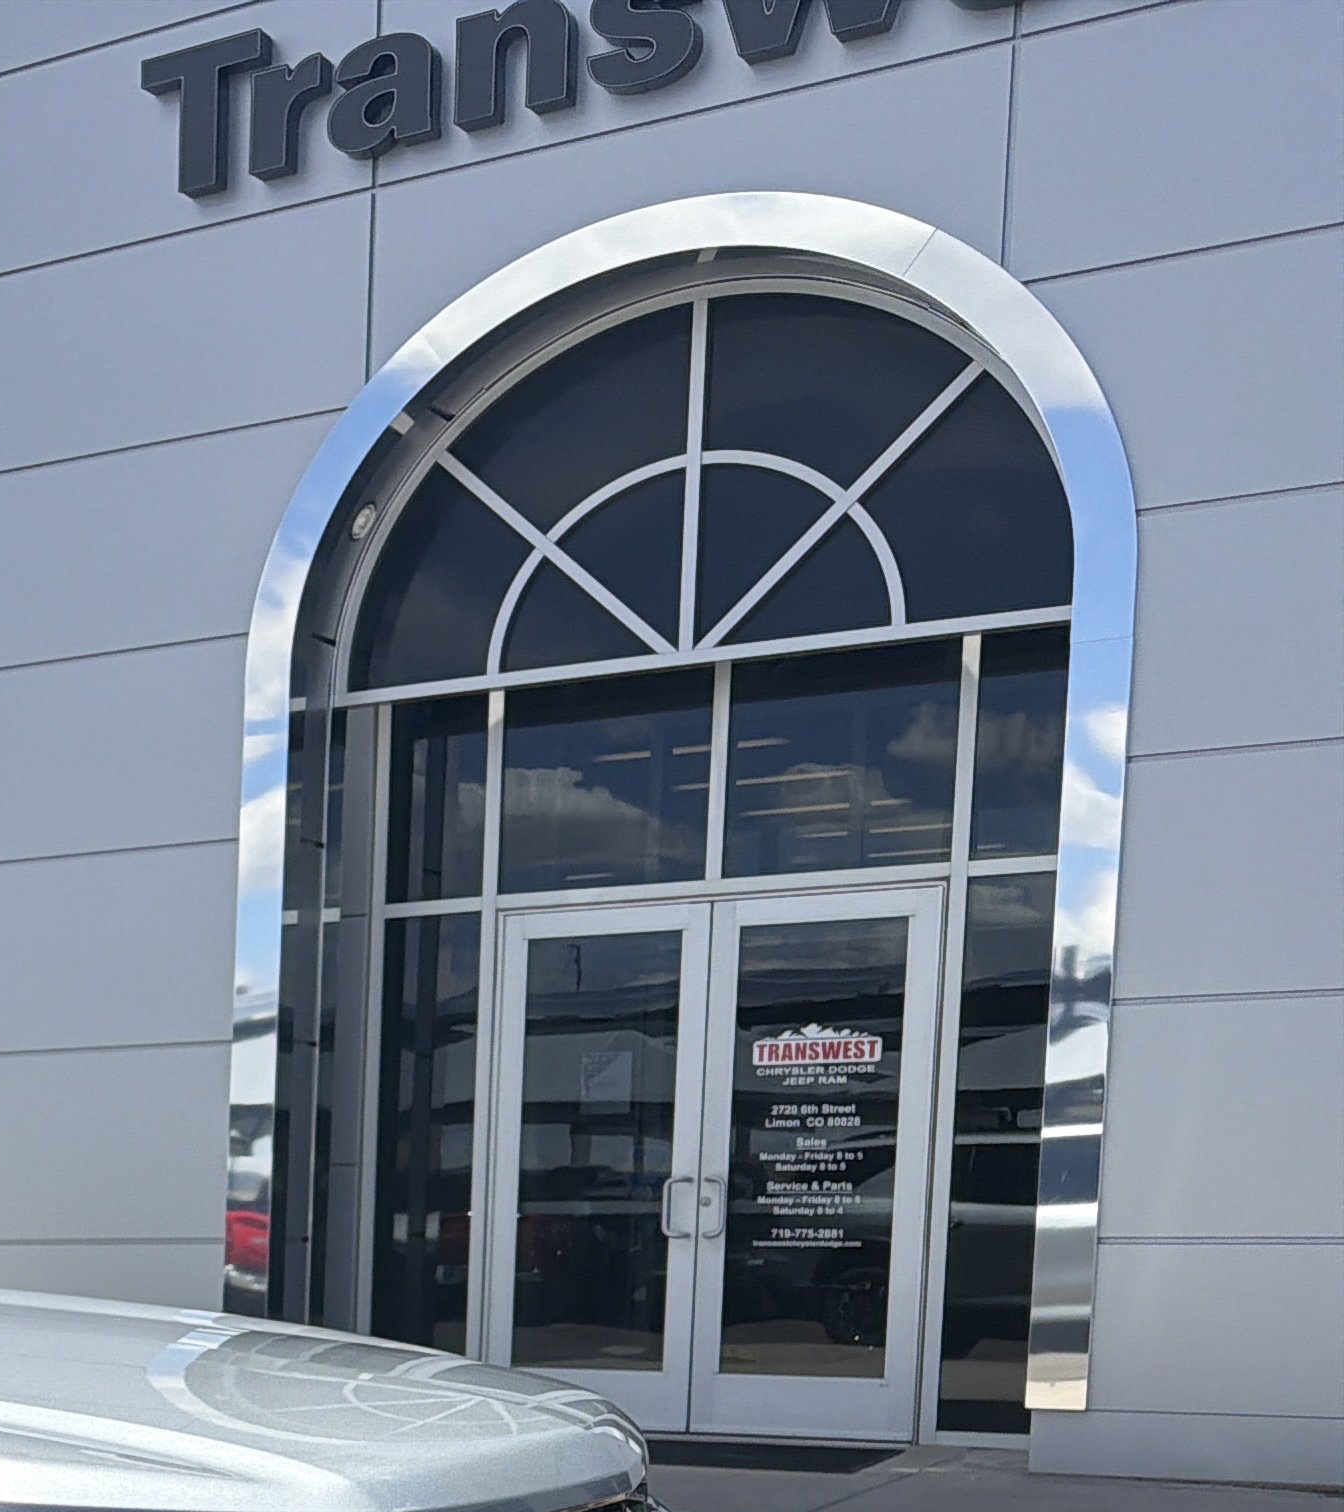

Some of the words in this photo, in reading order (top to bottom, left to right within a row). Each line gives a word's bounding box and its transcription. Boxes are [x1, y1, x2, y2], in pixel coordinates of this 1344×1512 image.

[756, 1039, 879, 1062] TRANSWEST
[755, 1066, 825, 1076] CHRYSLER
[828, 1064, 876, 1074] DODGE
[782, 1076, 815, 1086] JEEP
[818, 1075, 848, 1085] RAM
[821, 1103, 856, 1114] Street
[765, 1117, 800, 1128] Limon
[806, 1116, 825, 1127] CO
[796, 1136, 827, 1148] Sales
[759, 1152, 796, 1162] Monday
[804, 1151, 834, 1162] Friday
[775, 1162, 817, 1173] Saturday
[766, 1180, 809, 1191] Service
[811, 1180, 820, 1191] &
[822, 1180, 853, 1191] Parts
[757, 1195, 794, 1206] Monday
[802, 1195, 832, 1206] Friday
[773, 1205, 815, 1216] Saturday
